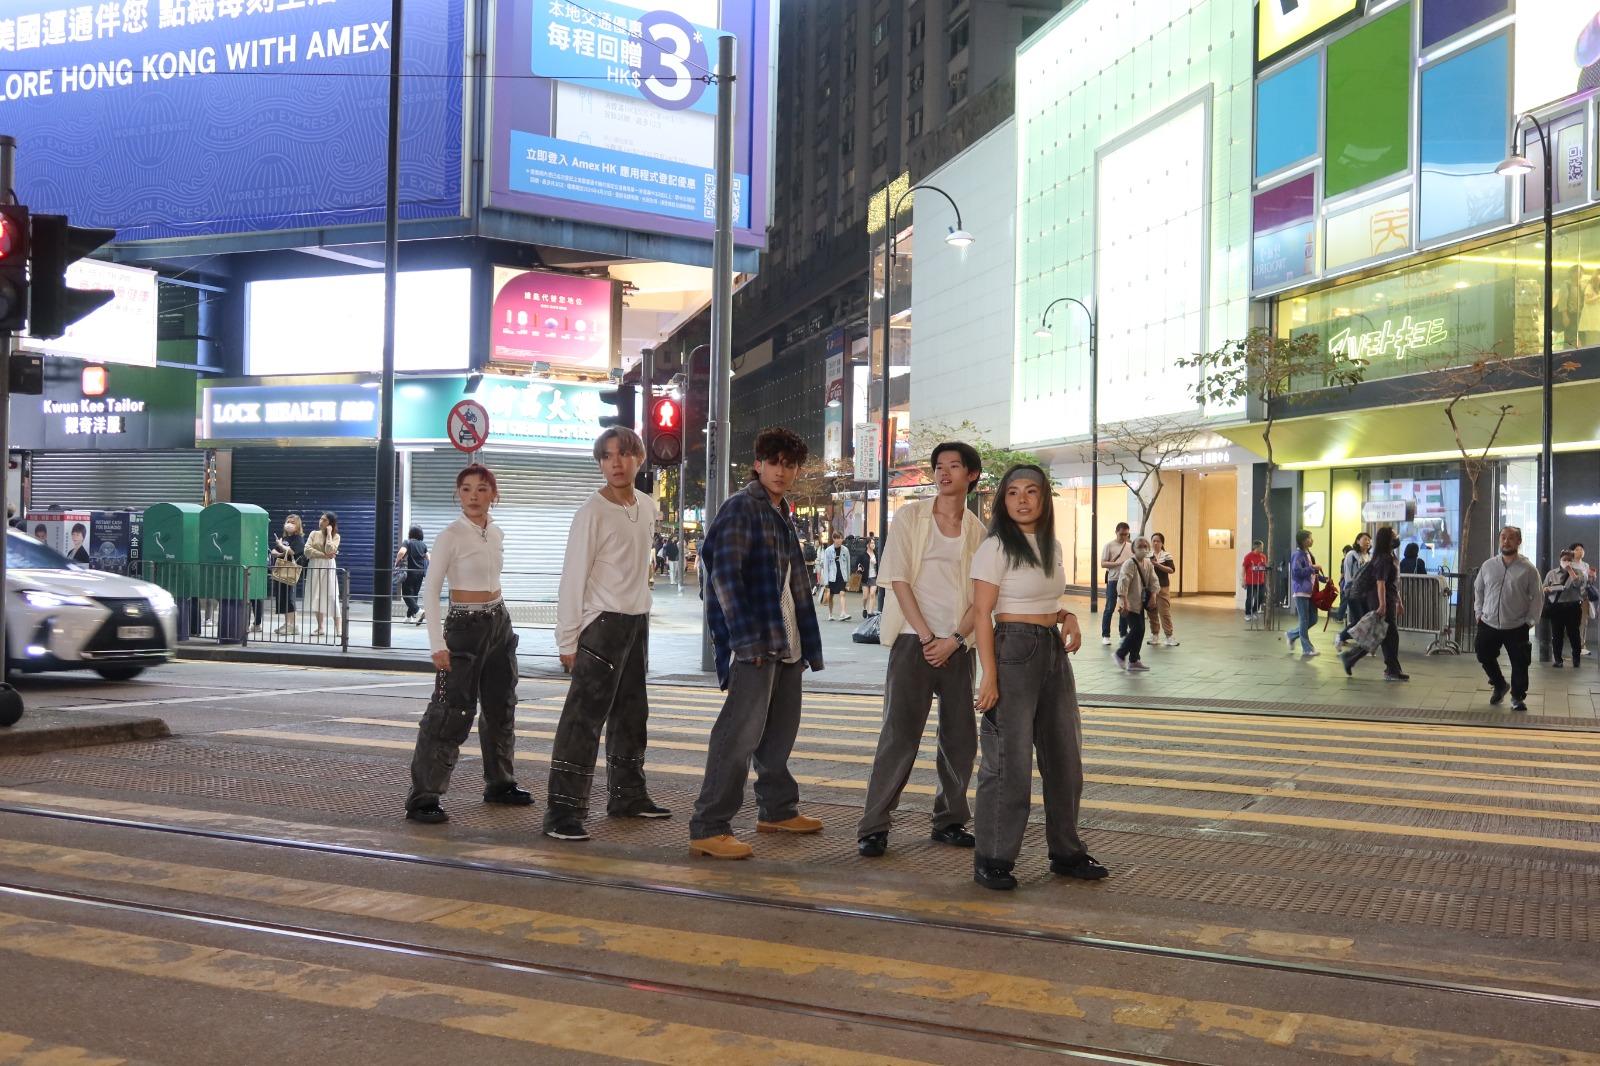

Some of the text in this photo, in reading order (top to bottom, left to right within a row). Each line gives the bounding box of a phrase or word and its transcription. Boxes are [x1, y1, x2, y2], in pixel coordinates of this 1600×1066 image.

[158, 0, 336, 29] 點綴每
[548, 1, 643, 39] 本地交通優惠
[61, 58, 133, 93] HONG
[142, 46, 216, 82] KONG
[225, 35, 297, 71] WITH
[306, 20, 390, 60] AMEX
[547, 21, 643, 69] 每程回贈
[607, 65, 641, 89] HK$
[358, 97, 389, 109] WORL
[114, 119, 191, 138] WORLD SERVICE
[208, 110, 337, 139] AMERICAN EXPRESS
[571, 157, 600, 172] Amex
[602, 162, 617, 175] HK
[228, 184, 313, 201] WORLD SERVICE
[332, 175, 405, 204] AMERICN
[92, 199, 210, 226] AMERICAN EXPRESS
[43, 398, 145, 413] Kwun Kee Tailor
[213, 403, 261, 423] LOCK
[265, 402, 337, 423] HEALTH
